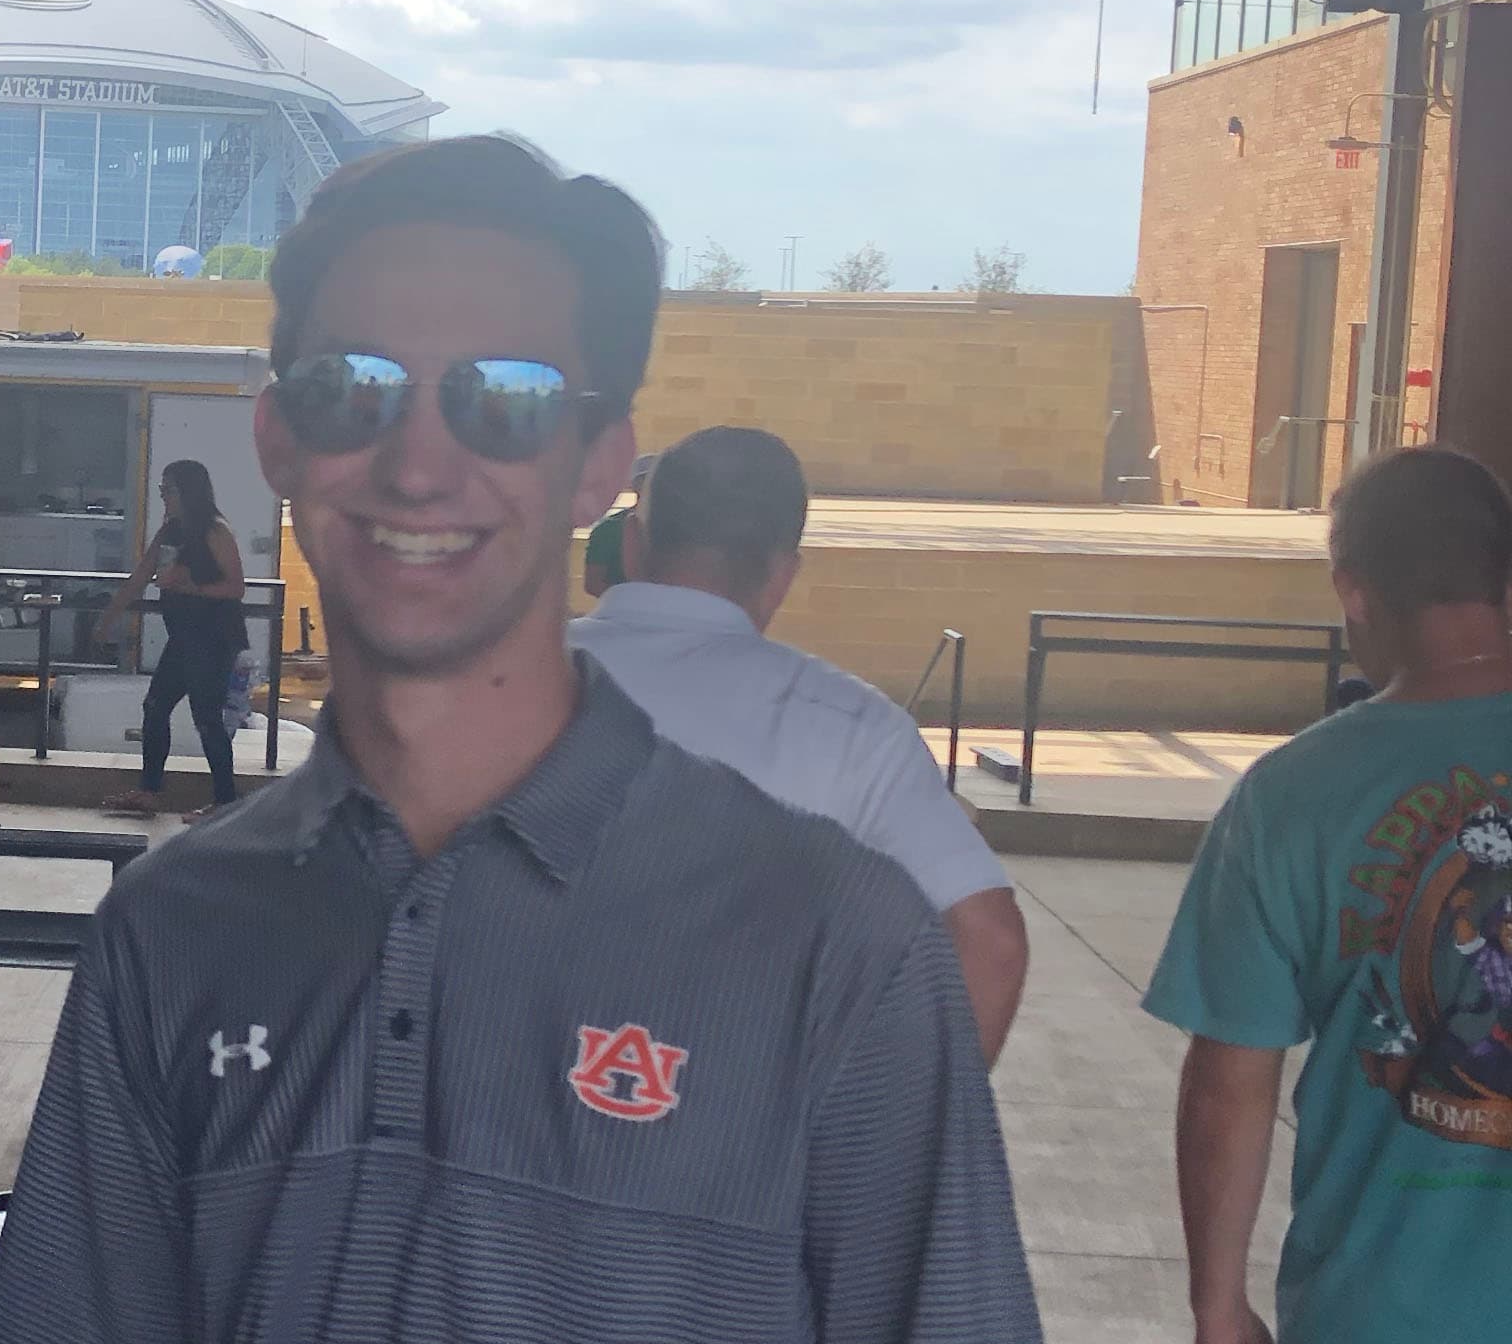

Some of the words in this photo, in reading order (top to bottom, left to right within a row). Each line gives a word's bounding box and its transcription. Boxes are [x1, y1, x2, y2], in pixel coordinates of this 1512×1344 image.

[57, 79, 161, 105] STADIUM
[1336, 151, 1360, 169] EXIT
[1340, 766, 1492, 959] KAPPA
